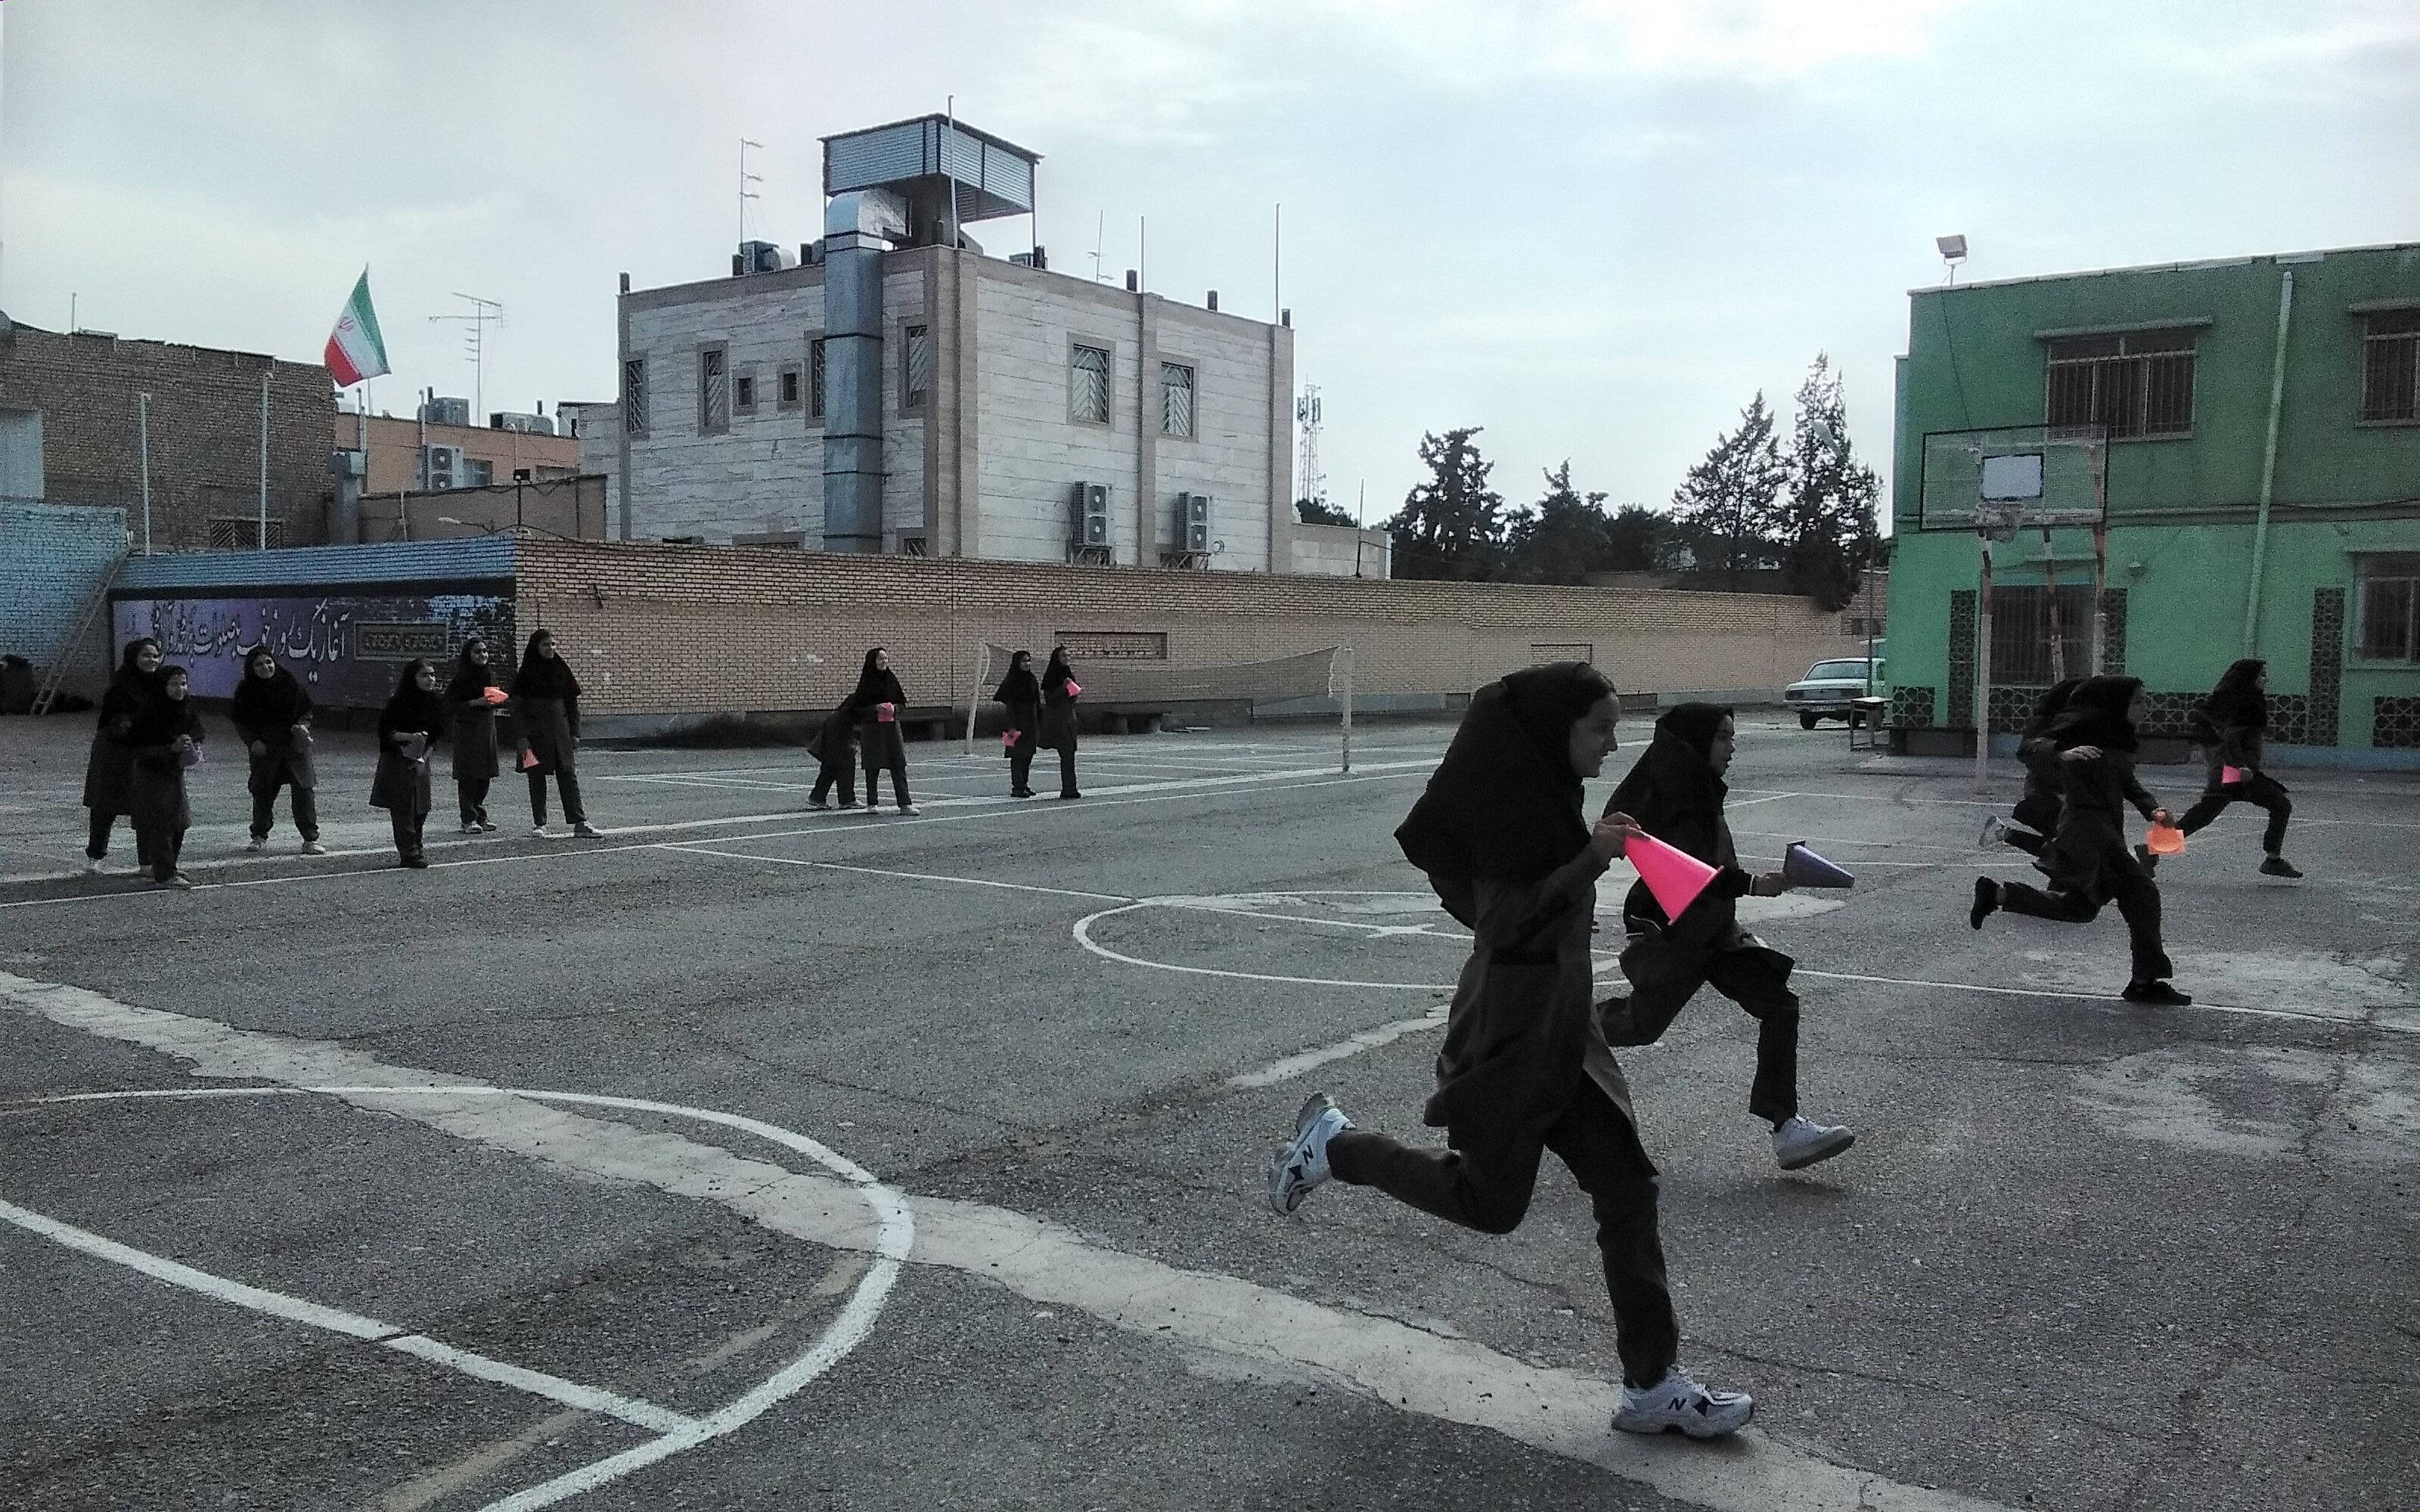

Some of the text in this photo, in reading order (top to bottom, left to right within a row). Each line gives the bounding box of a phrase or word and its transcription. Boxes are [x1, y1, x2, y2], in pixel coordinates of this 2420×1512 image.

[271, 609, 296, 657] روز
[288, 597, 327, 683] یک
[318, 611, 350, 663] آغاز
[1302, 1145, 1314, 1165] N
[1668, 1398, 1688, 1411] N
